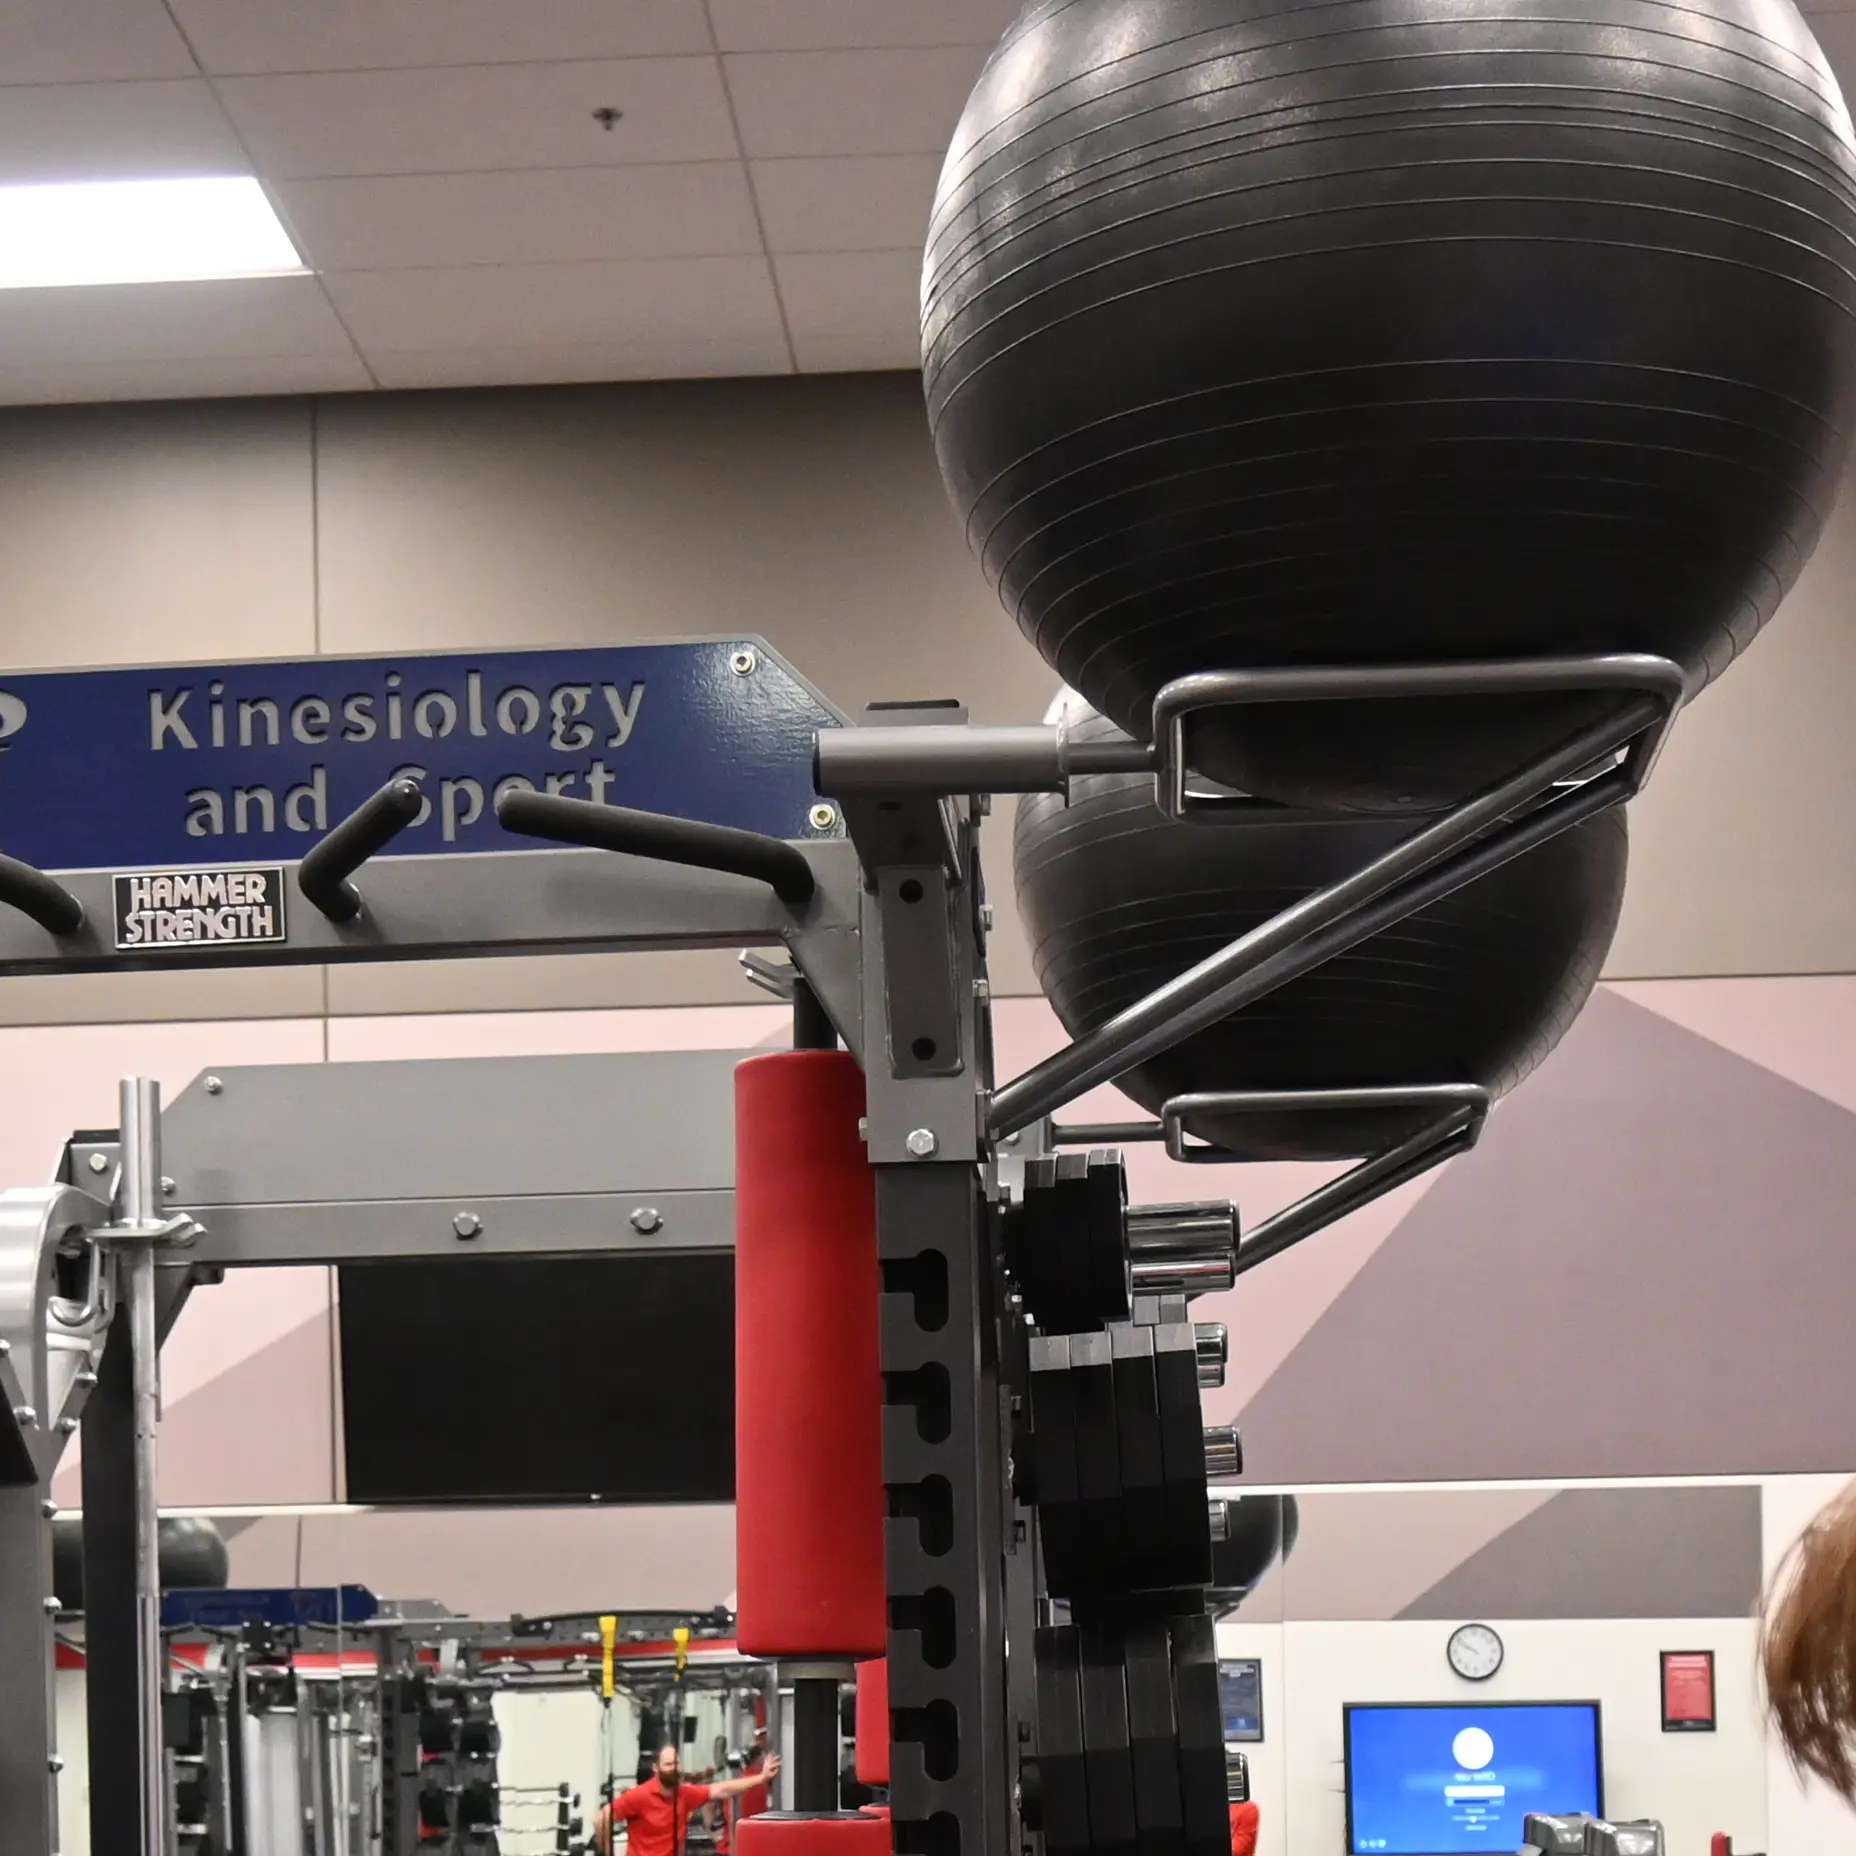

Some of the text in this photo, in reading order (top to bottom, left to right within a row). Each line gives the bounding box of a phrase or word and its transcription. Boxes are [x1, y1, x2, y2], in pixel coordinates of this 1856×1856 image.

[148, 669, 646, 753] Kinesiology
[185, 764, 329, 838] and
[130, 872, 266, 909] HAMMER
[124, 905, 274, 943] STRENGTH
